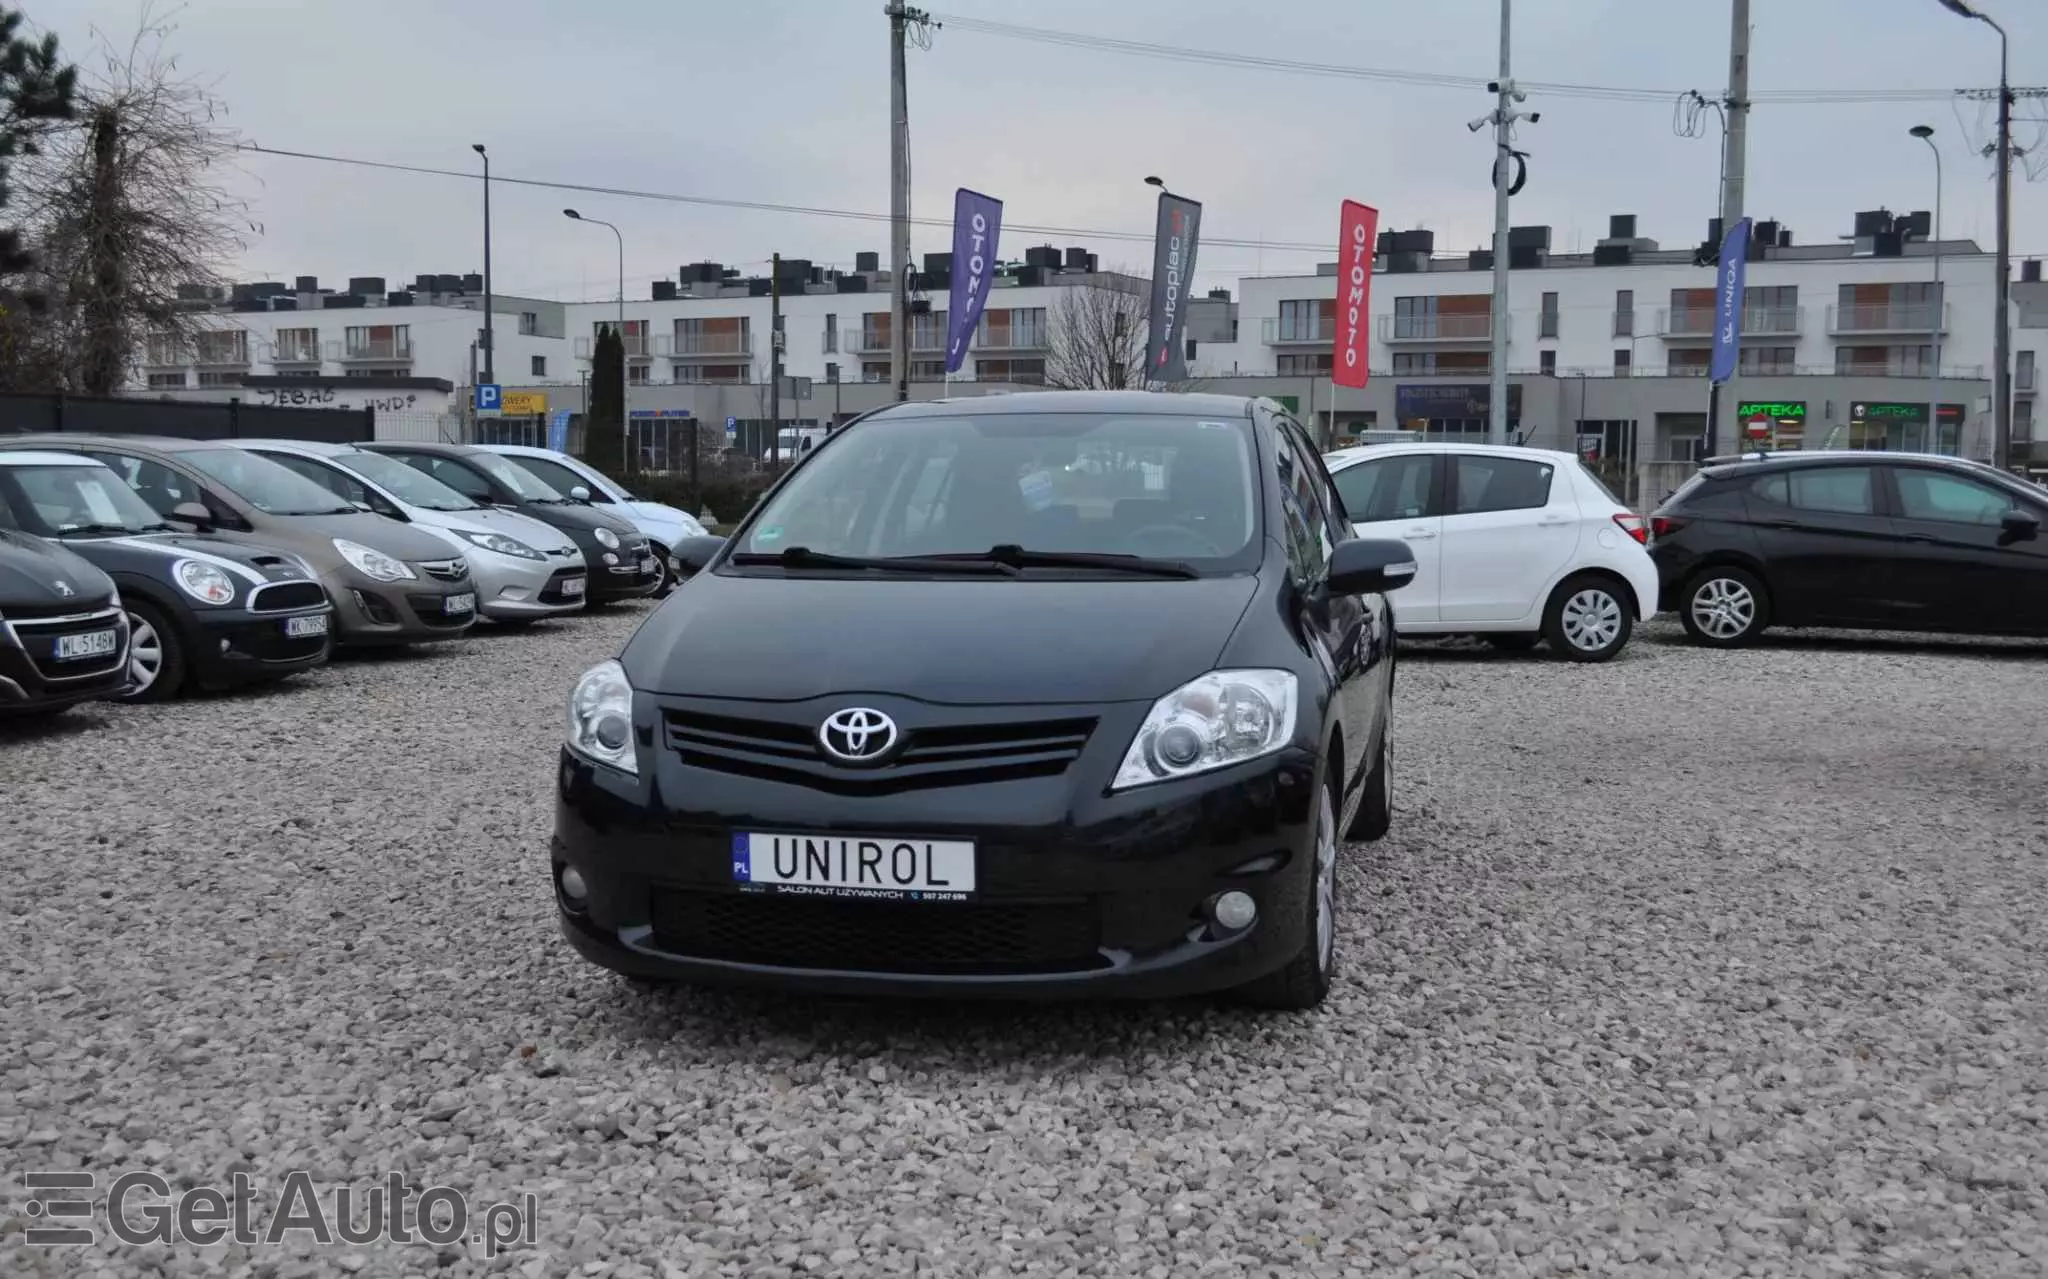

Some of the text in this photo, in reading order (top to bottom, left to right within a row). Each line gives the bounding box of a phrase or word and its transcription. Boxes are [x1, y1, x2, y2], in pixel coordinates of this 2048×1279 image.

[1345, 223, 1366, 367] OTOMOTO
[481, 387, 496, 407] P
[1739, 404, 1804, 417] APTEKA
[734, 862, 748, 873] PL
[774, 838, 949, 886] UNIROL
[777, 885, 813, 895] SALON
[814, 887, 834, 896] AUT
